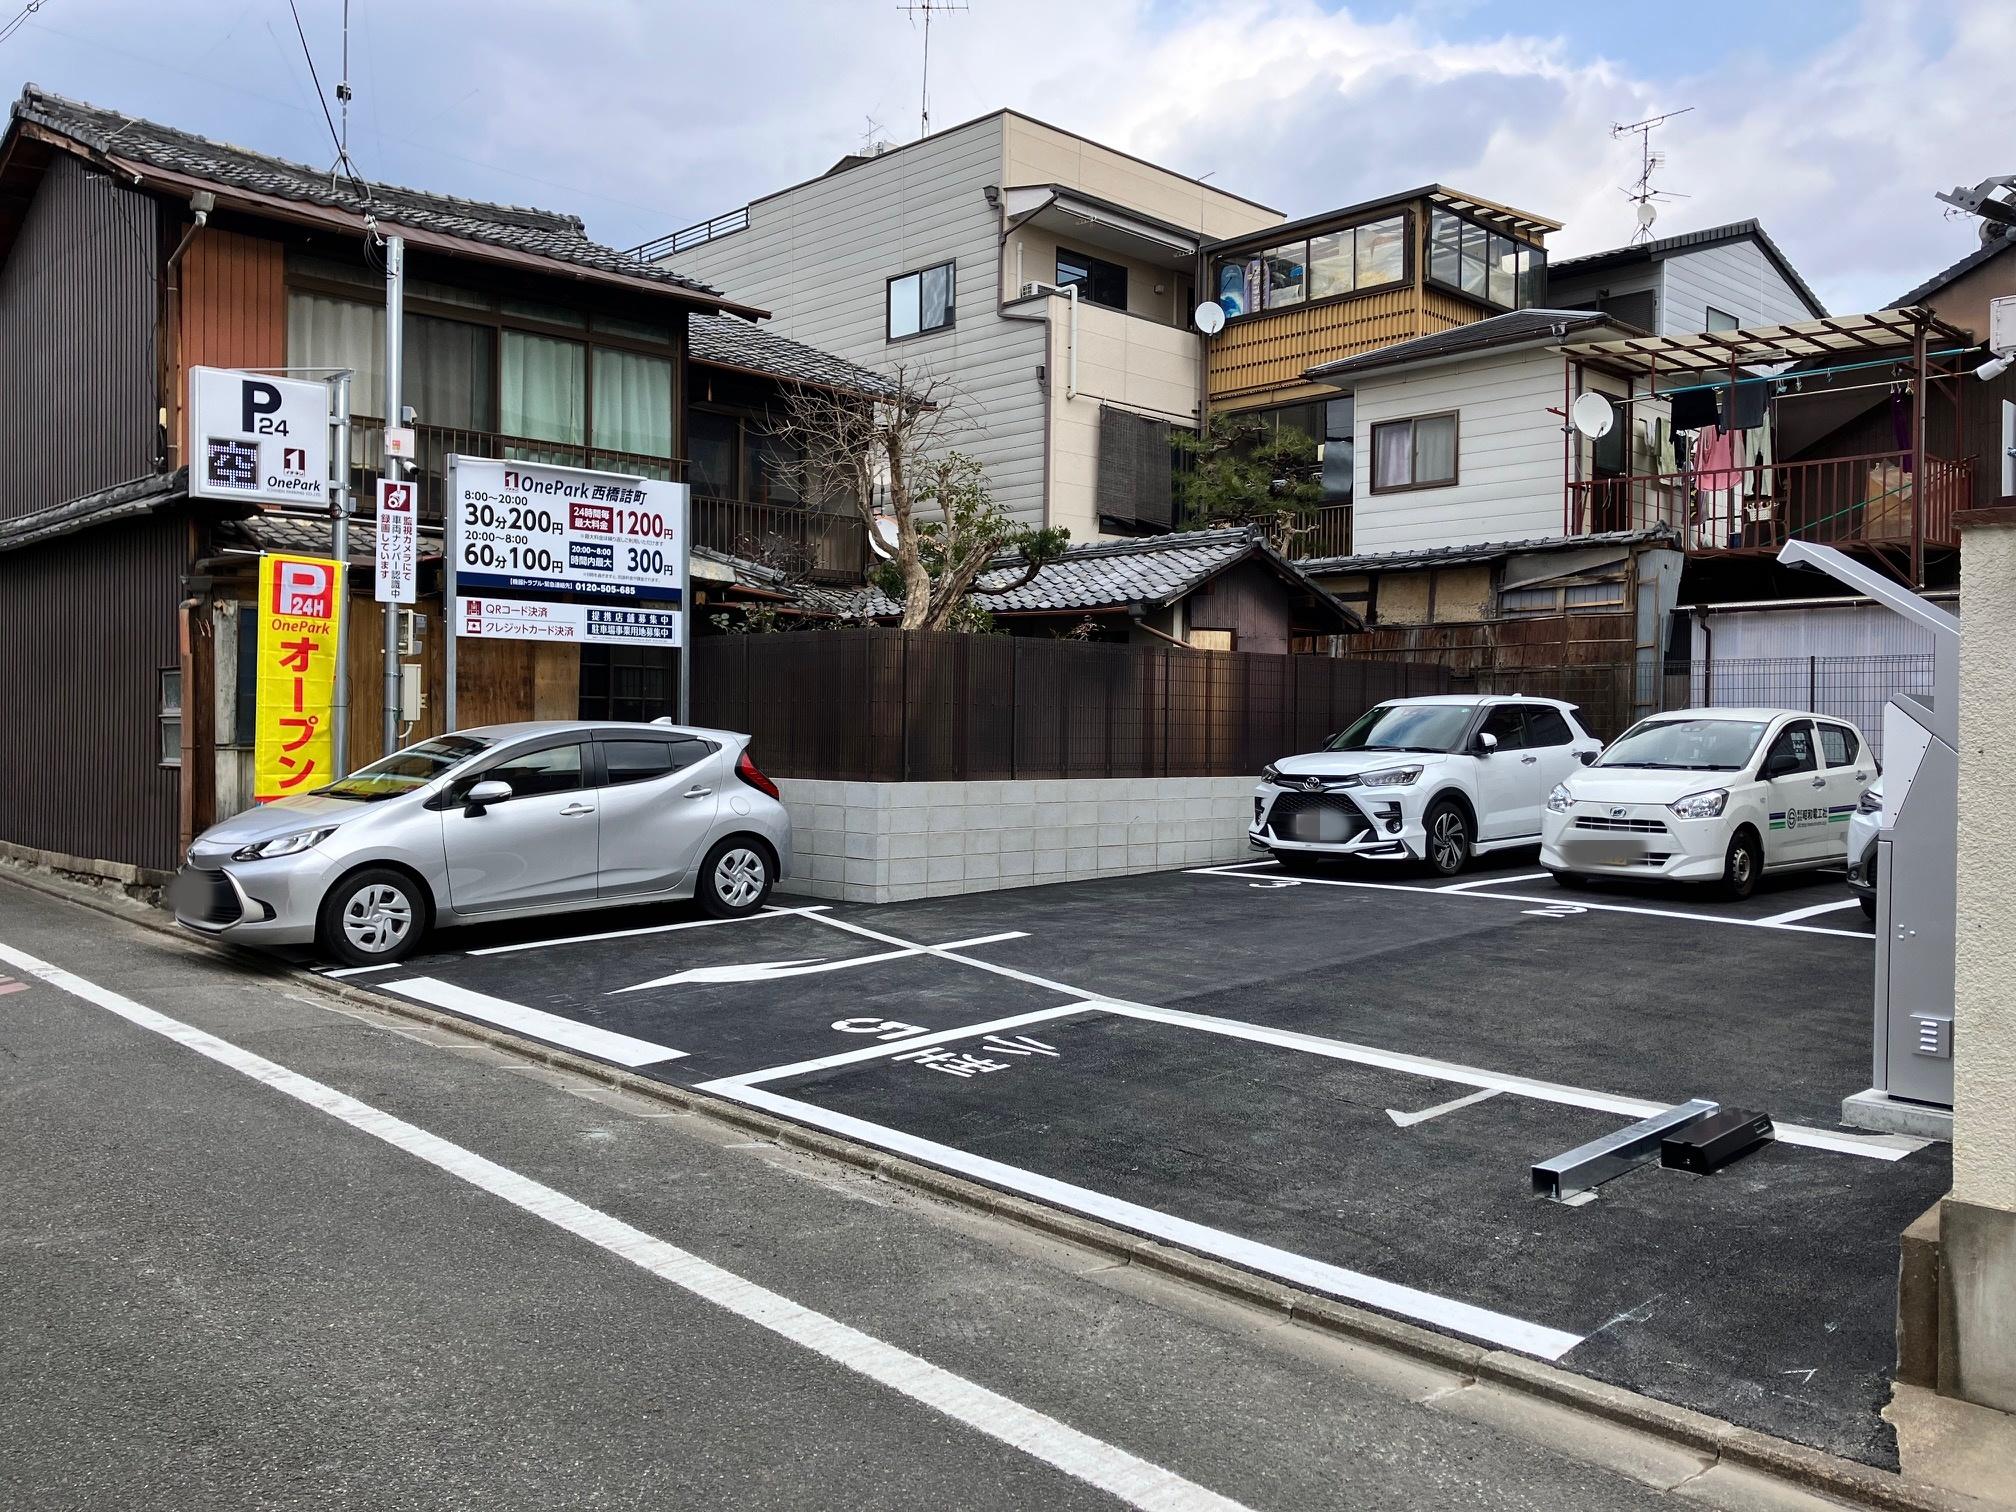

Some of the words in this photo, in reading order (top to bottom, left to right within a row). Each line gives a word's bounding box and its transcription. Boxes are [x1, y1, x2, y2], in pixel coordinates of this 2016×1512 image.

[242, 380, 282, 433] P
[258, 418, 290, 436] 24
[208, 441, 257, 489] 空
[268, 476, 320, 493] OnePark
[521, 476, 588, 499] OnePark
[591, 485, 648, 506] 西橋詰町
[464, 502, 564, 536] 30分200円
[573, 506, 610, 519] 24時間毎
[574, 518, 609, 531] 最大料金
[616, 510, 673, 540] 1200円
[380, 513, 390, 580] 録画しています
[391, 514, 401, 599] 車両ナンバー認識中
[402, 516, 413, 581] 監視カメラにて
[464, 542, 564, 574] 60分100円
[570, 555, 613, 569] 時間内最大
[627, 547, 673, 576] 300円
[279, 562, 327, 615] P
[575, 583, 636, 595] 0120-505-685
[291, 596, 324, 617] 24H
[485, 603, 548, 618] QRコード決済
[271, 618, 331, 635] OnePark
[485, 622, 575, 638] クレジットカード決済
[278, 636, 320, 790] オープン
[1519, 905, 1588, 918] 2
[831, 1017, 931, 1040] 5
